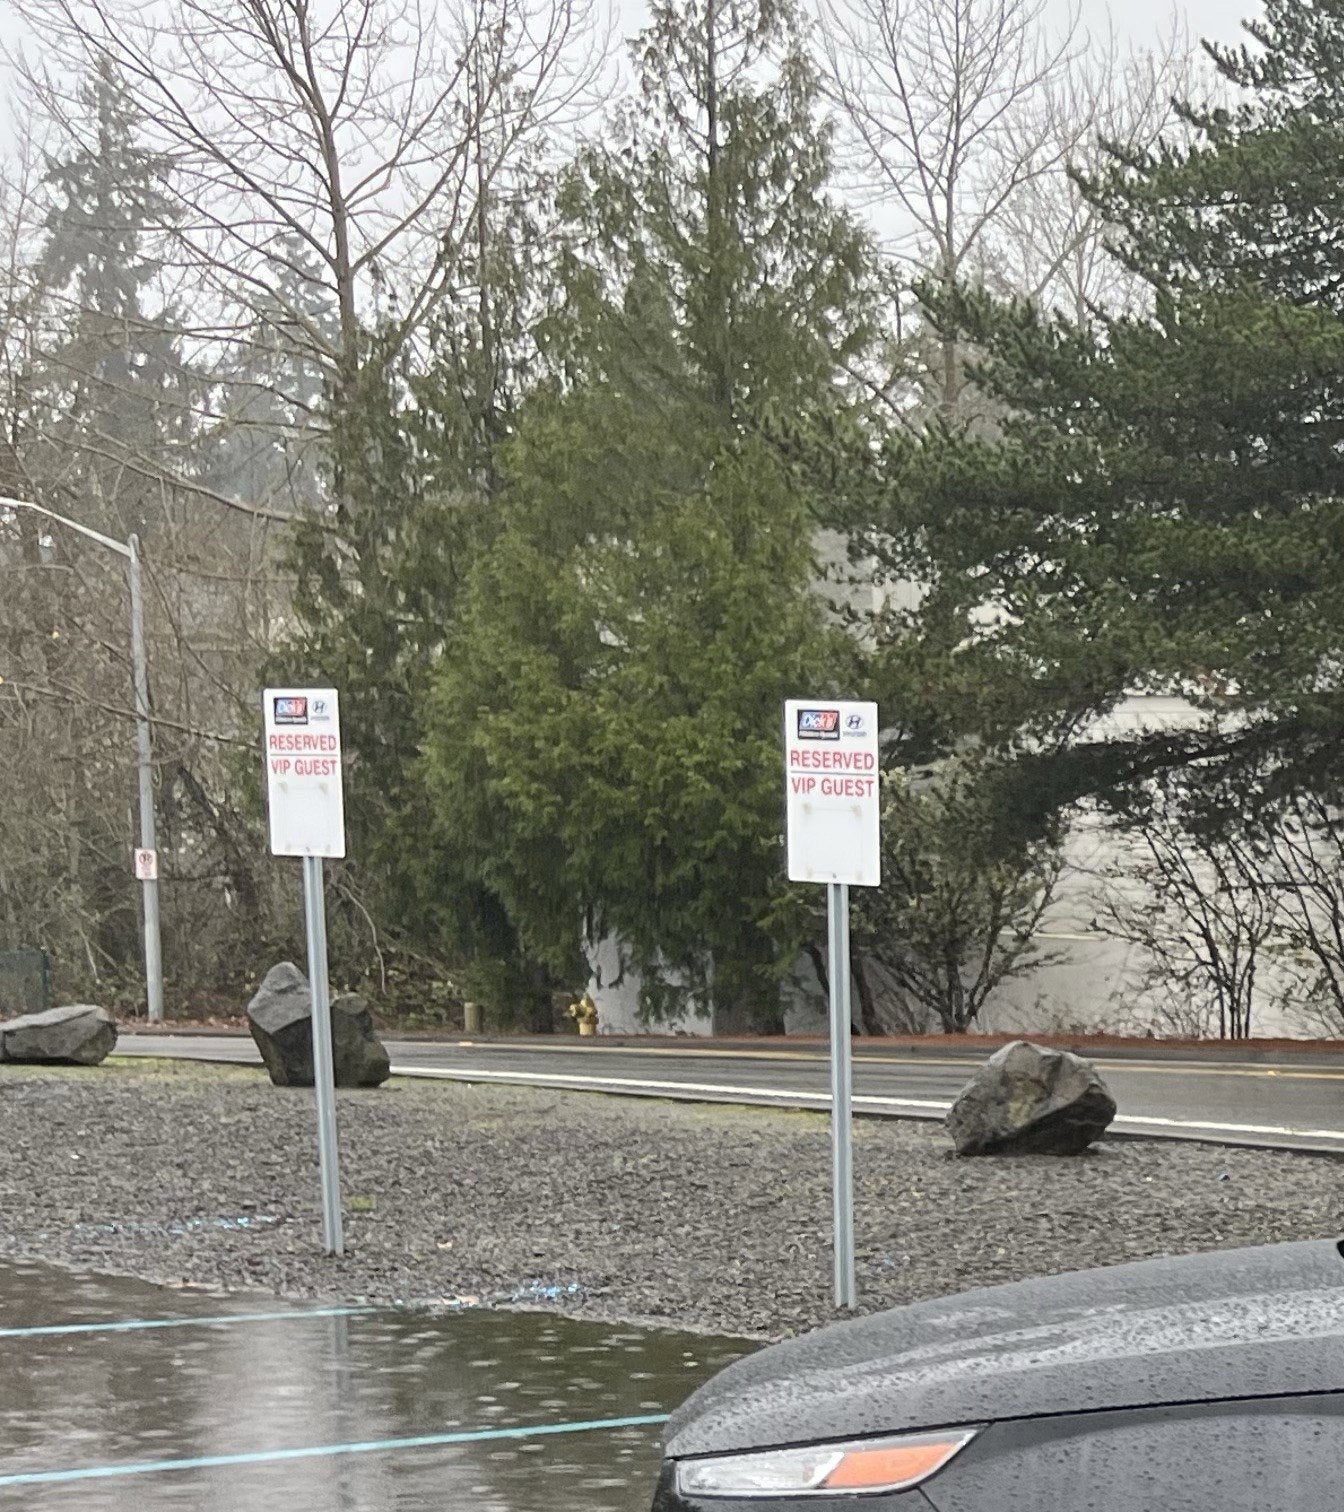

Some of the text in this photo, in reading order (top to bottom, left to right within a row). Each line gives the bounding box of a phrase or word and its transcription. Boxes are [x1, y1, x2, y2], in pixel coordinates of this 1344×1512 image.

[269, 734, 336, 750] RESERVED
[271, 759, 337, 775] VIP GUEST
[790, 750, 874, 770] RESERVED
[791, 777, 874, 797] VIP GUEST
